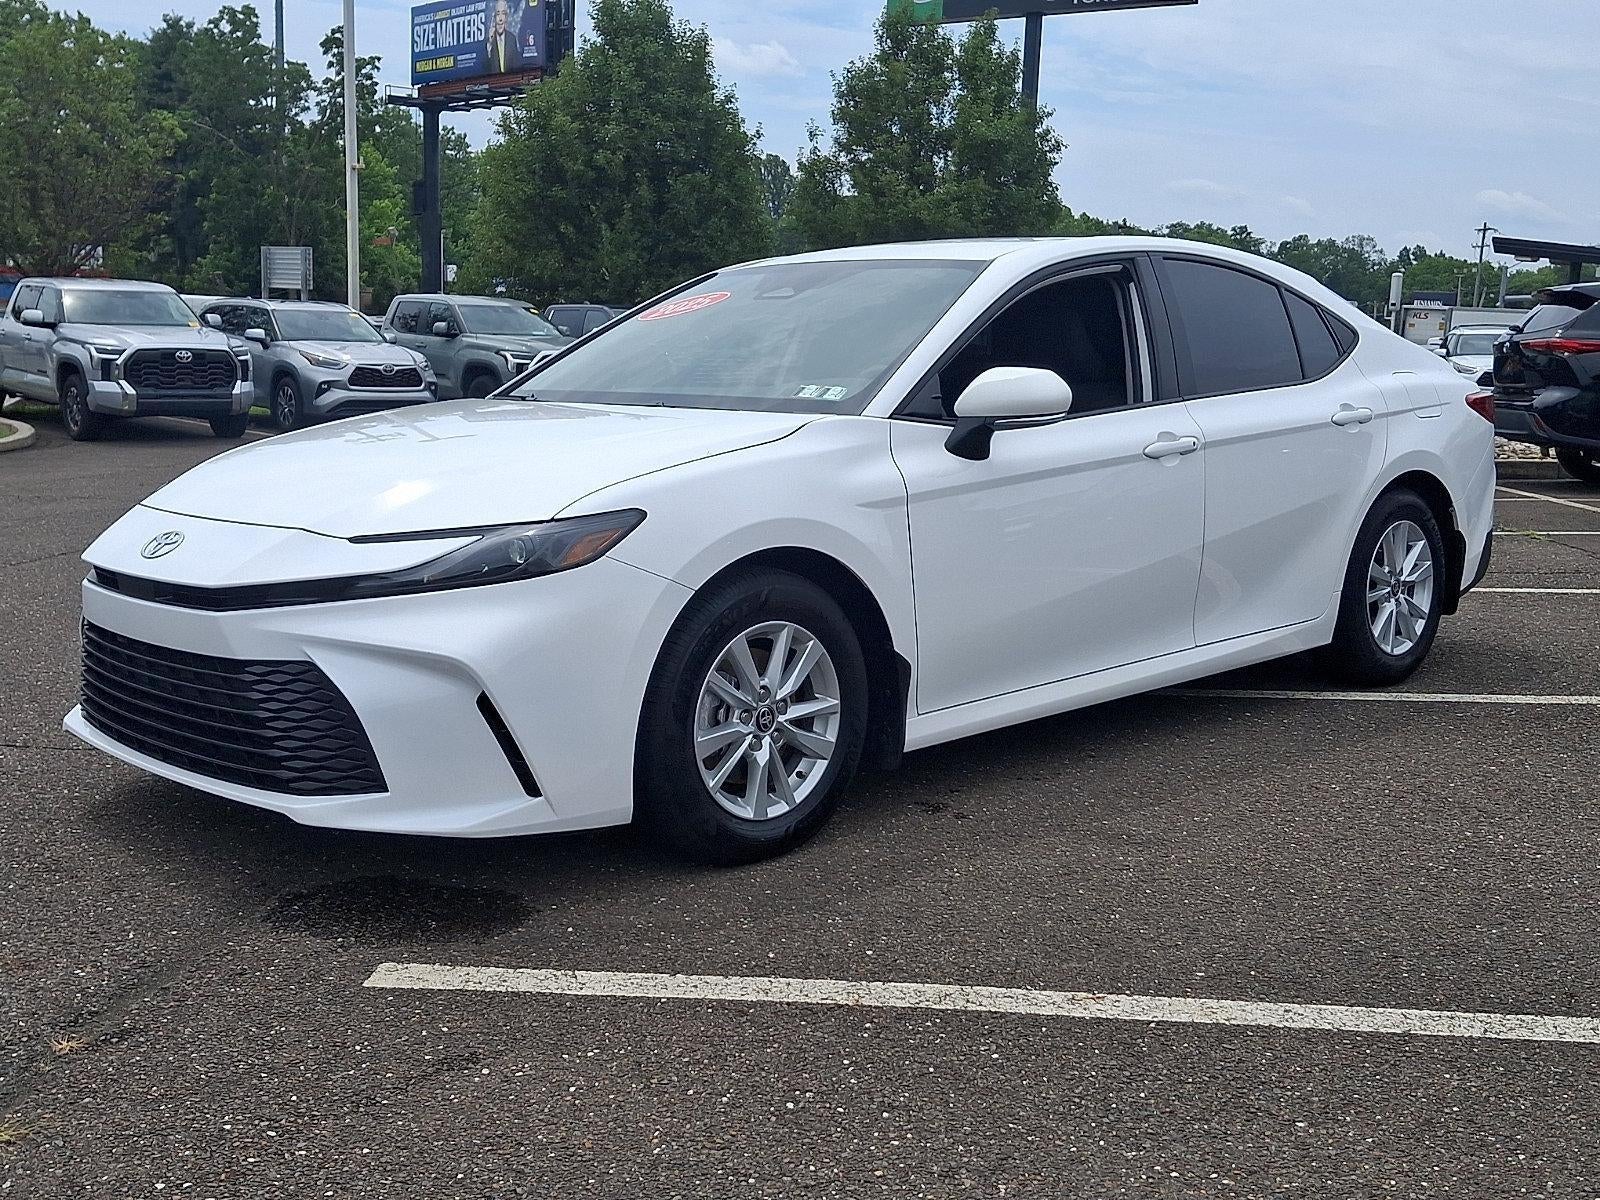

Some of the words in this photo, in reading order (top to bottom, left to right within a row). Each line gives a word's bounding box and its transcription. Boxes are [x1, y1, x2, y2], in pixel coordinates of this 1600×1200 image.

[466, 4, 475, 13] LAW
[414, 24, 434, 52] SIZE
[436, 12, 485, 48] MATTERS
[416, 60, 432, 72] MORGAN
[433, 59, 436, 69] &
[436, 56, 454, 68] MORGAN
